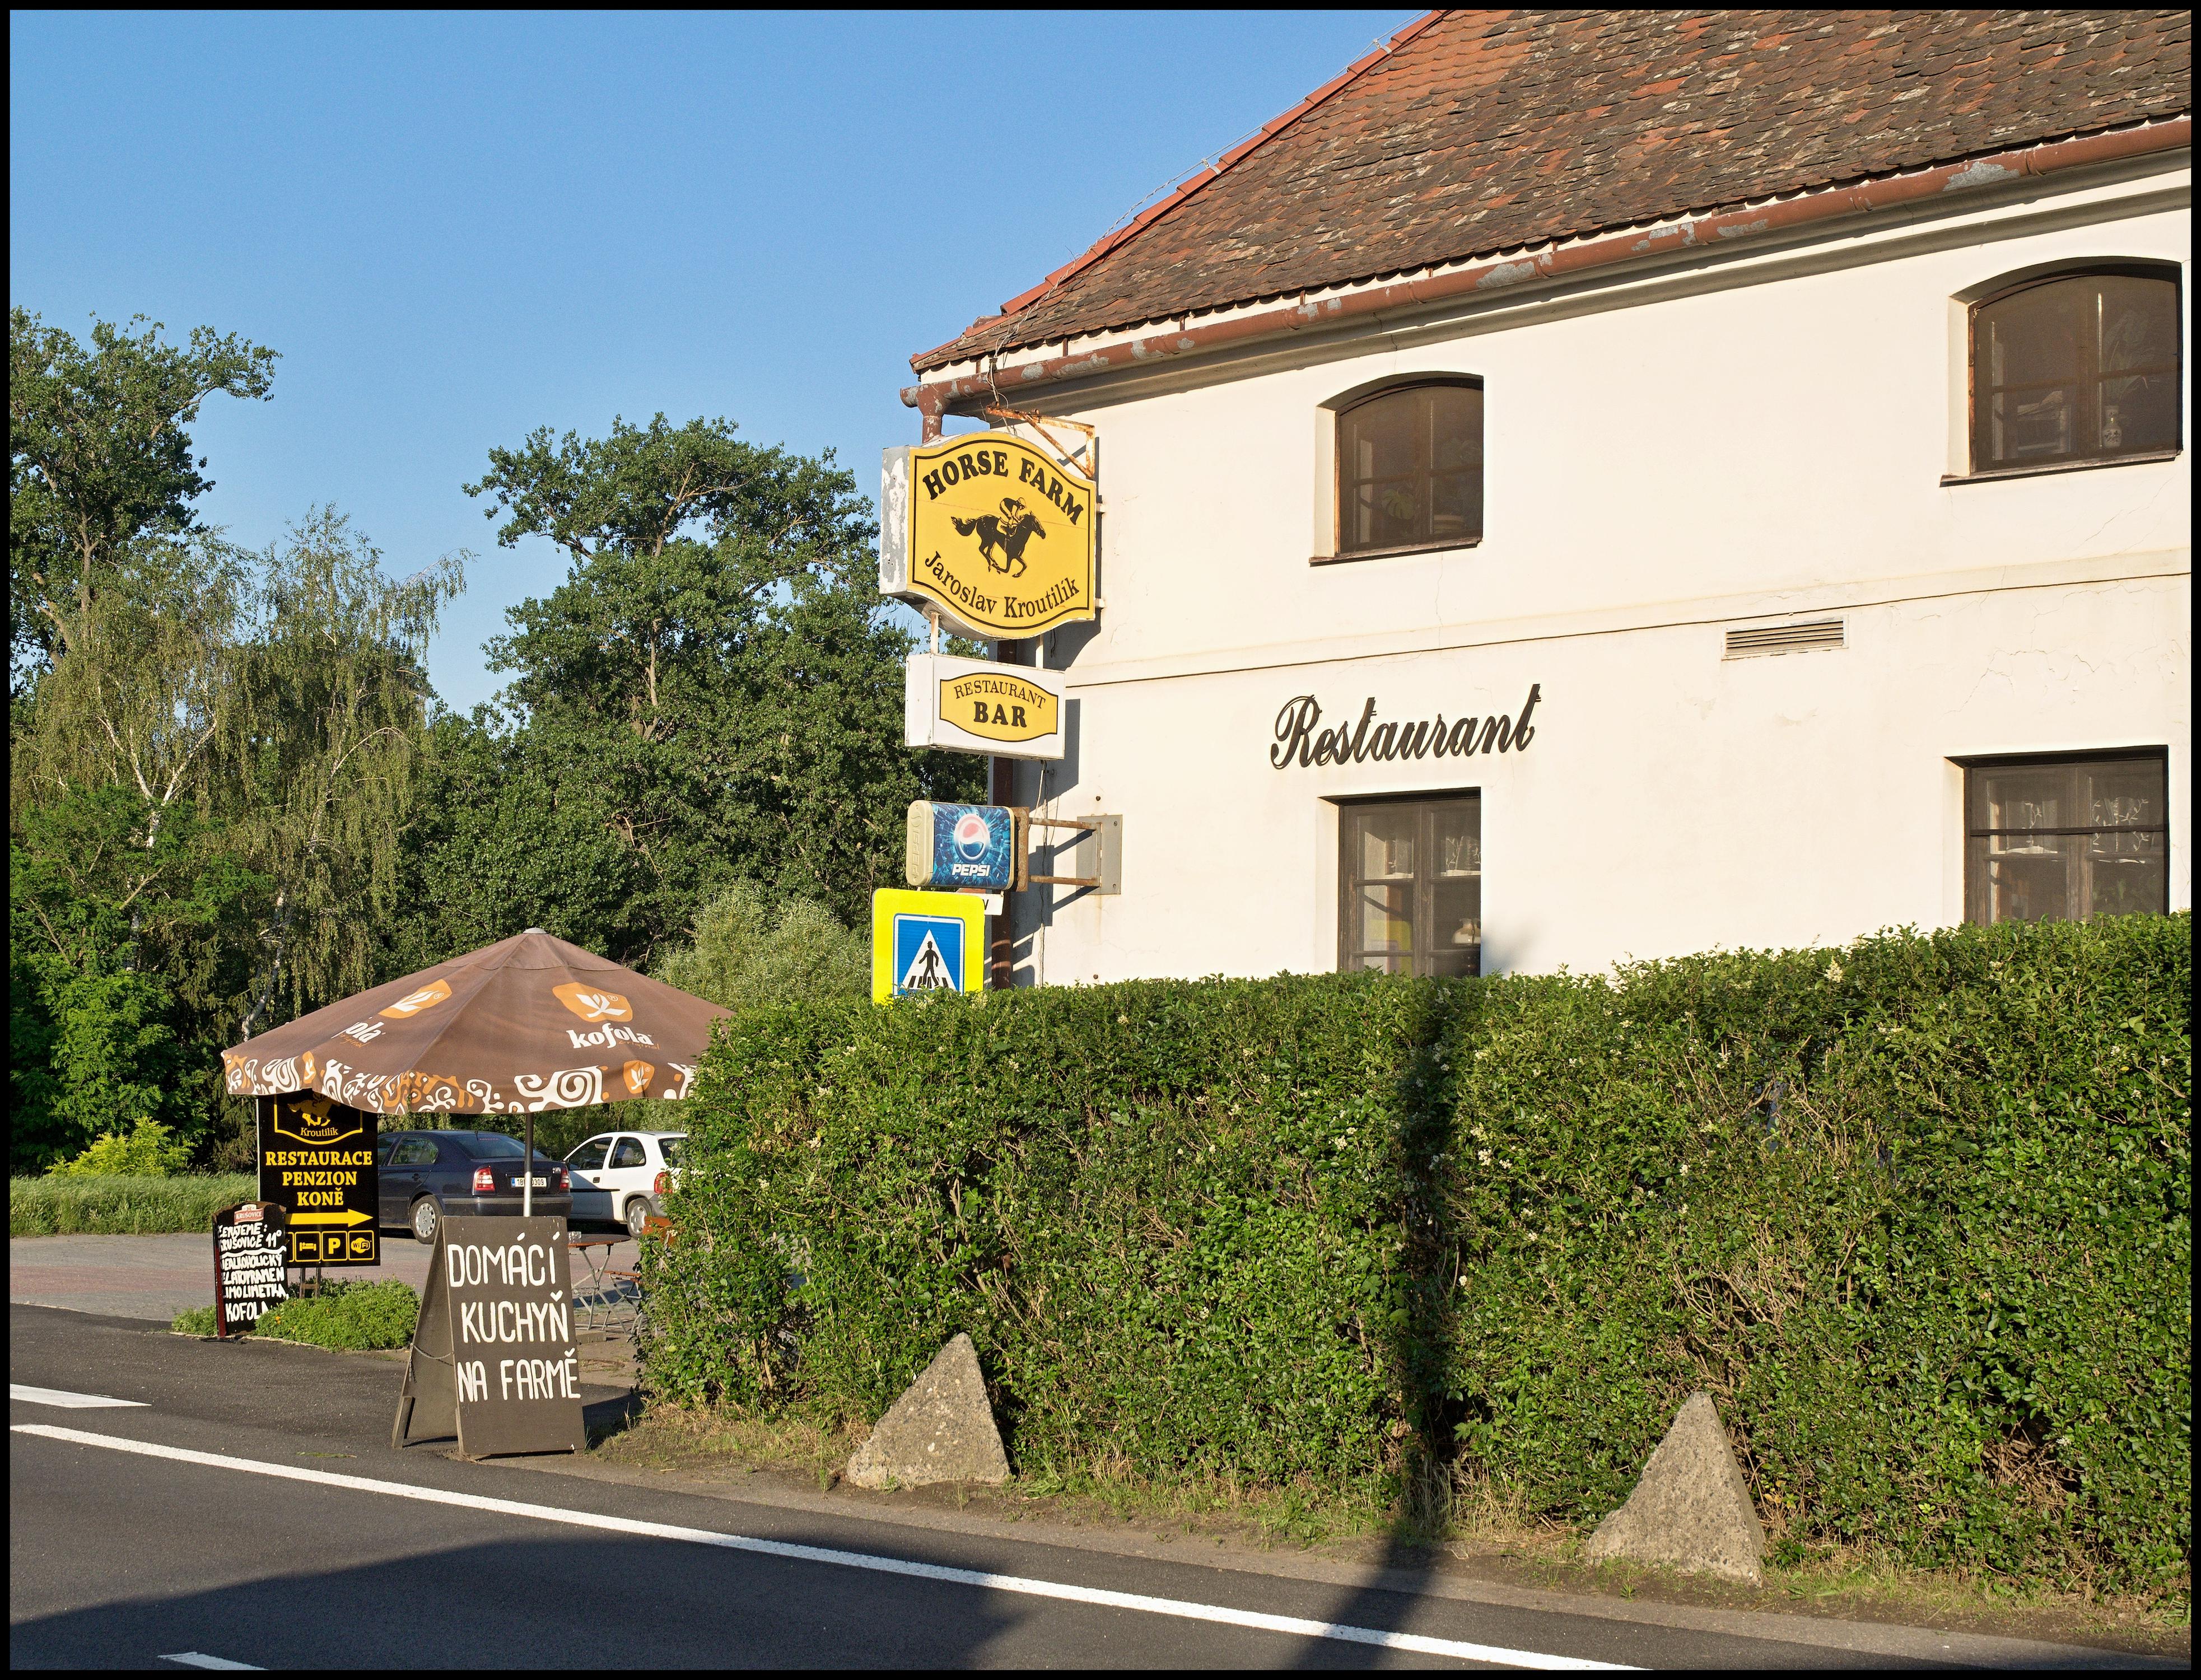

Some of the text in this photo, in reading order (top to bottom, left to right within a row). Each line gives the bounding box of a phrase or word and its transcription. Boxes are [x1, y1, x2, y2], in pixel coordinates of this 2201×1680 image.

[922, 450, 1084, 525] HORSE FARM
[925, 550, 1080, 618] Jaroslav Kroutilík
[954, 680, 1046, 709] RESTAURANT
[973, 701, 1027, 728] BAR
[1271, 684, 1541, 770] Restaurant
[952, 864, 991, 877] PEPSI
[566, 1023, 654, 1049] kofola
[265, 1151, 372, 1166] RESTAURACE
[282, 1171, 357, 1186] PENZION
[297, 1187, 343, 1206] KONĚ
[328, 1238, 341, 1254] P
[447, 1231, 560, 1287] DOMÁCÍ
[461, 1290, 569, 1343] KUCHYŇ
[457, 1347, 581, 1402] NA FARMĚ
